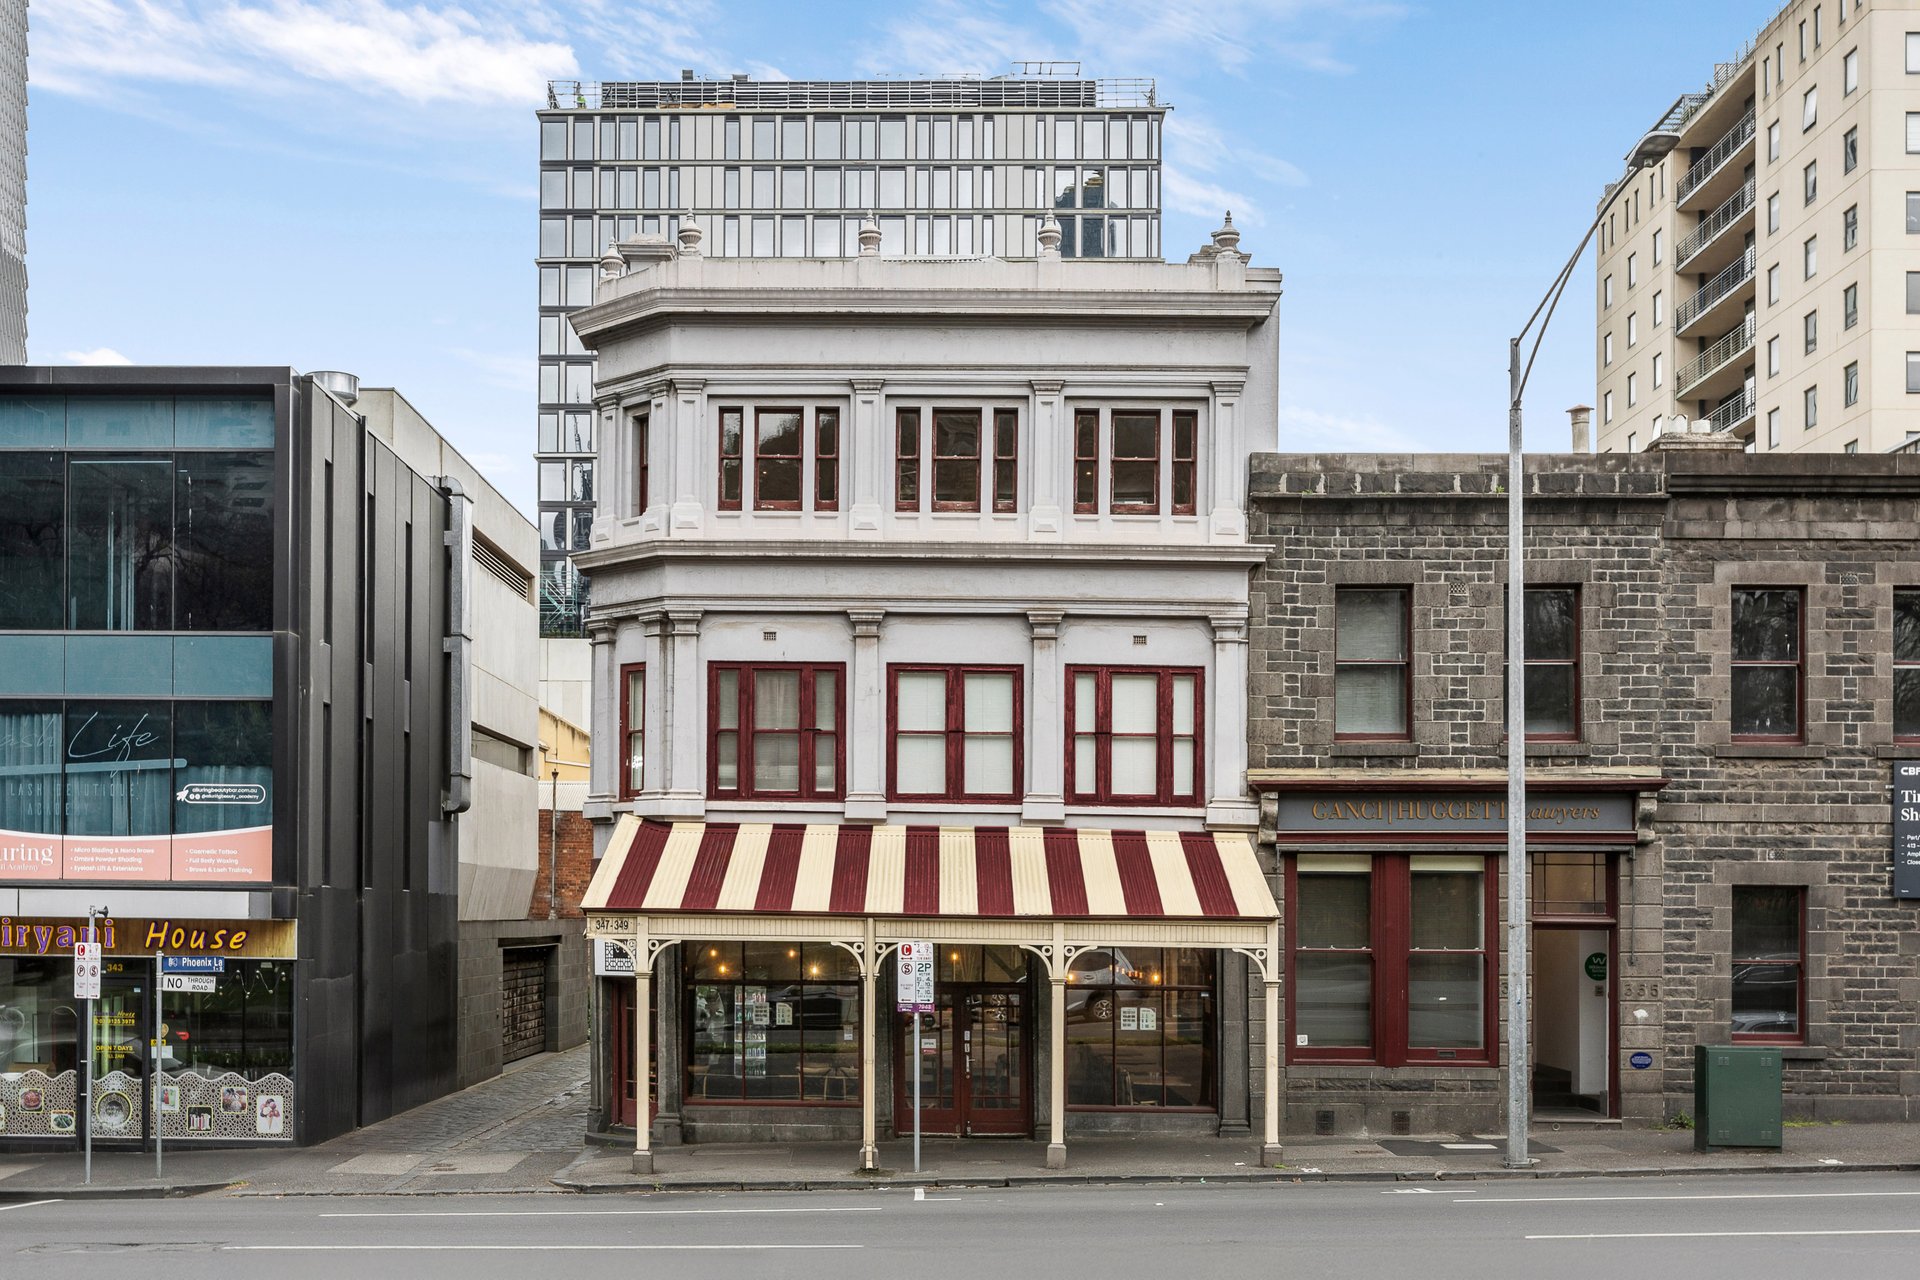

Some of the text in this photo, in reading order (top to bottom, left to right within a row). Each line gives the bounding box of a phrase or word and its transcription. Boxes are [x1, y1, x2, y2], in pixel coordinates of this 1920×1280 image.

[68, 711, 159, 778] Life
[1312, 800, 1383, 820] GANCI
[596, 920, 629, 930] 347-349
[145, 921, 249, 949] House
[106, 963, 123, 972] 343
[182, 957, 223, 967] Phoenix La
[917, 963, 931, 972] 2P
[167, 977, 183, 989] NO
[1624, 983, 1659, 997] 355
